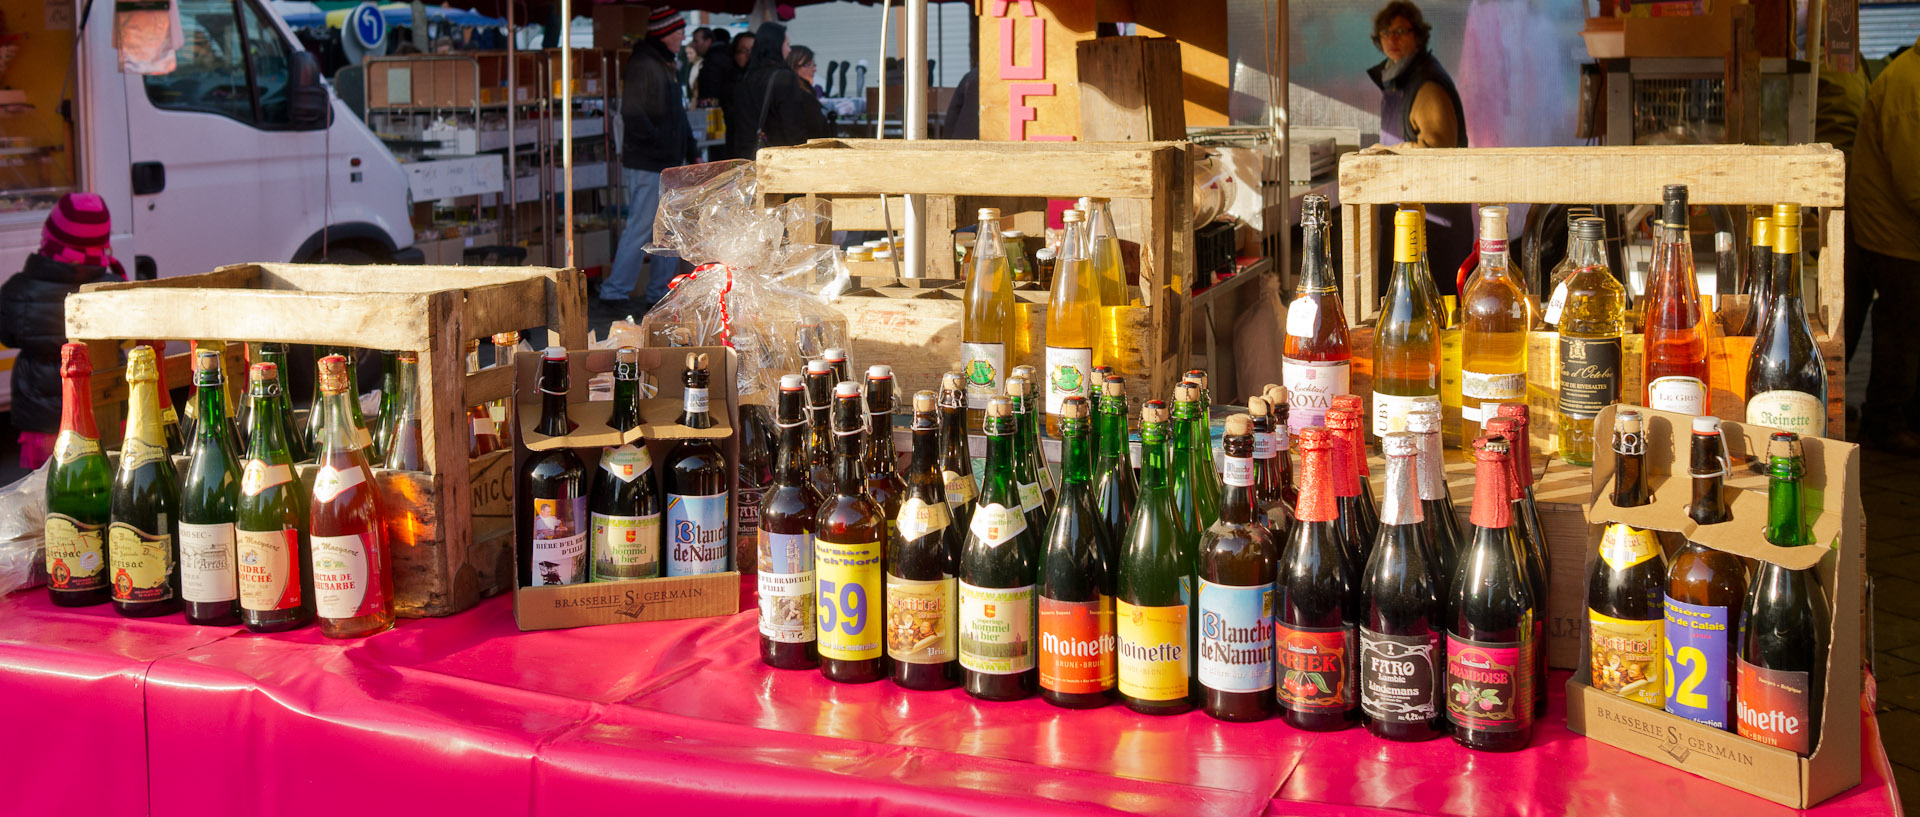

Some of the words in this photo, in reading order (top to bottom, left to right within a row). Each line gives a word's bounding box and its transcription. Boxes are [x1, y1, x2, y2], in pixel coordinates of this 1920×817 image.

[1294, 383, 1329, 393] Cocktail
[1288, 391, 1335, 408] ROYA
[1379, 400, 1388, 431] UBY
[1761, 411, 1810, 426] Reinette
[192, 531, 207, 539] SEC
[613, 546, 647, 555] hommel
[622, 555, 639, 563] bier
[673, 543, 688, 562] de
[340, 573, 352, 581] DE
[555, 594, 621, 609] BRASSERIE
[644, 588, 703, 601] GERMAIN
[819, 579, 867, 635] 59
[972, 620, 1010, 633] hommel
[1202, 610, 1272, 644] Blanche
[1677, 617, 1688, 627] de
[1691, 621, 1725, 631] Calais
[981, 632, 1000, 641] bier
[1043, 631, 1115, 657] Moinette
[1202, 637, 1213, 661] de
[1214, 641, 1272, 665] Namur
[1278, 648, 1337, 673] KRIEK
[1371, 656, 1415, 676] FARO
[1450, 662, 1508, 684] FRAMBOISE
[1664, 636, 1708, 709] 62
[1368, 680, 1420, 696] Lindemans
[1378, 673, 1406, 684] Lambic
[1737, 697, 1799, 735] oinette
[1597, 706, 1664, 738] BRASSERIE
[1688, 736, 1753, 766] GERMAIN
